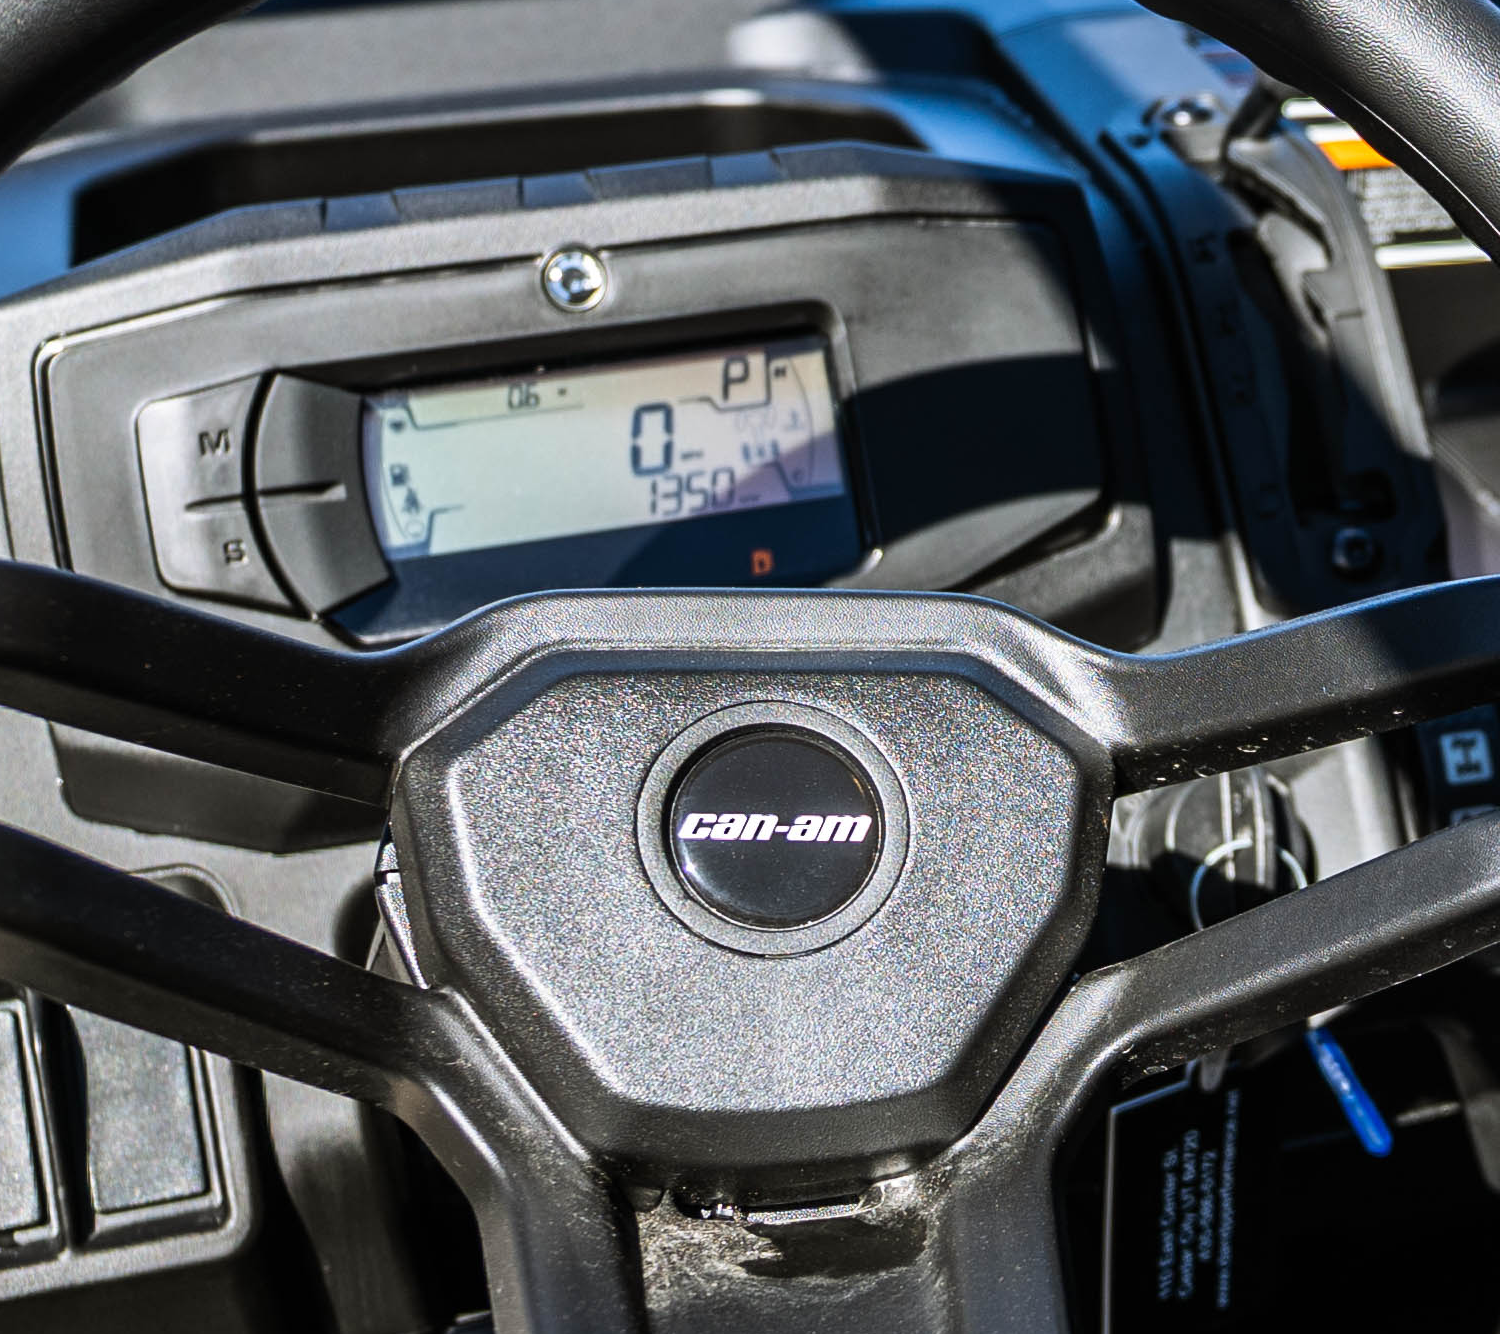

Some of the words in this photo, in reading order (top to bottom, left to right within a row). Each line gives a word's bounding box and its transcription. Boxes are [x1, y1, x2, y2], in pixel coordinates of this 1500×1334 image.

[722, 357, 750, 401] P
[199, 428, 232, 456] M
[630, 402, 674, 477] 0
[647, 466, 736, 517] 1350
[223, 538, 246, 564] S
[677, 813, 873, 842] can-am
